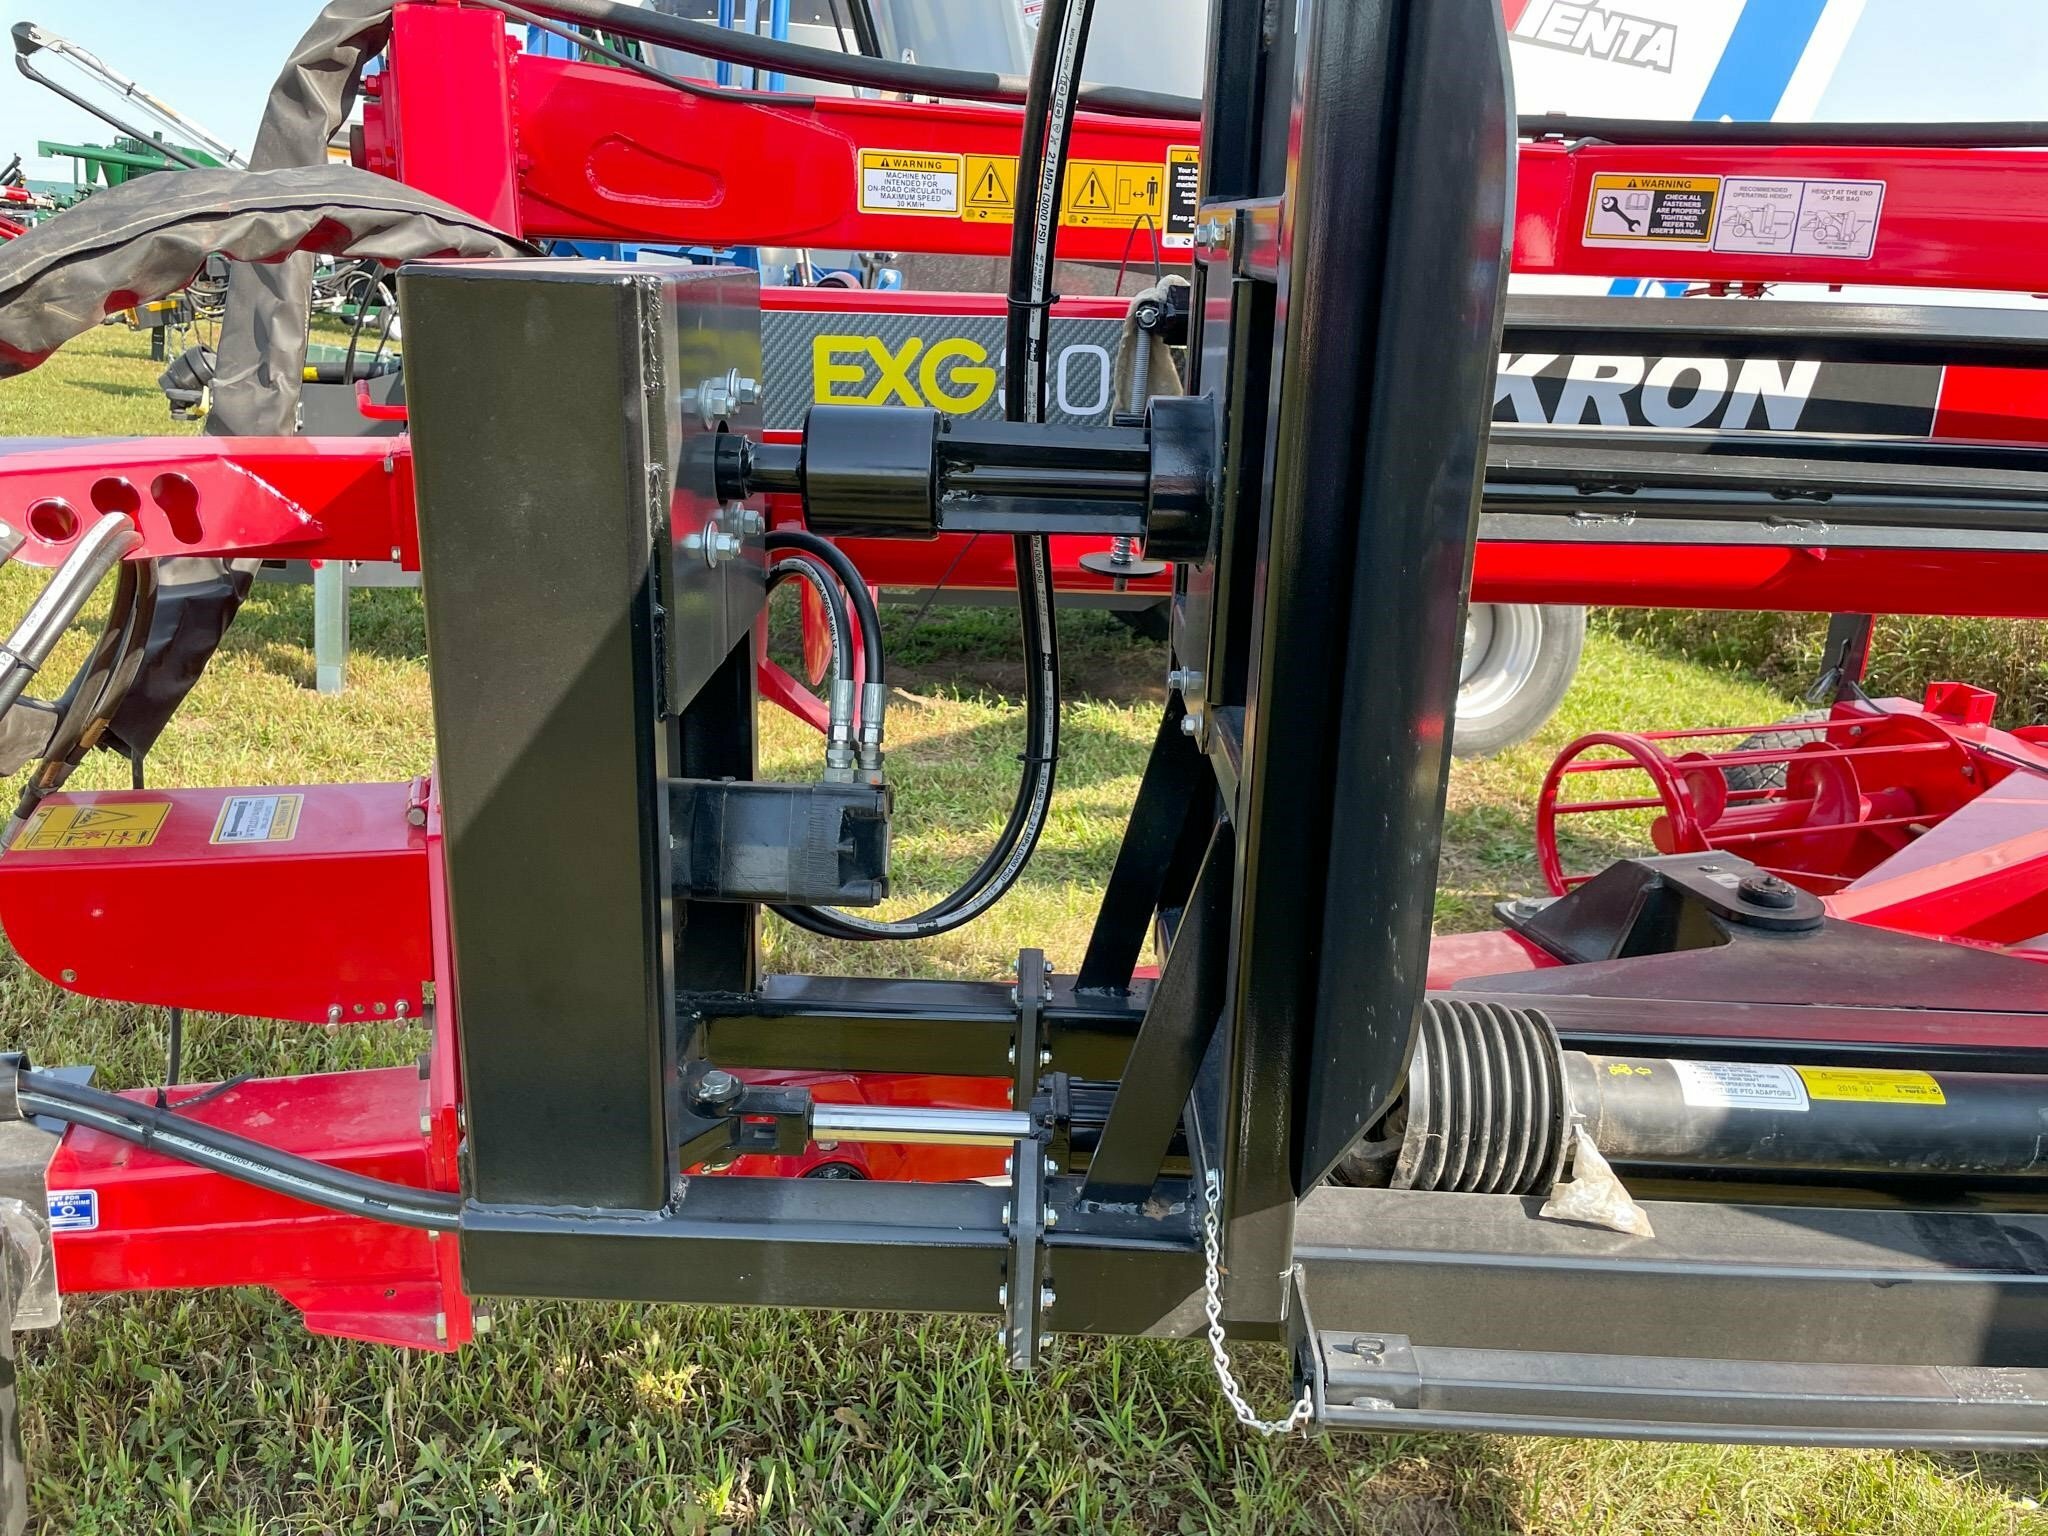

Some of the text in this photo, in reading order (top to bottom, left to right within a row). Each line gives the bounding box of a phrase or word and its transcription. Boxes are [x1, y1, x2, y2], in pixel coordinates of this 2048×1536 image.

[1048, 151, 1056, 163] 21
[893, 159, 942, 169] WARNING
[886, 172, 920, 180] MACHINE
[1043, 167, 1054, 190] MPa
[884, 179, 921, 187] INTENDED
[1641, 179, 1692, 189] WARNING
[867, 185, 952, 195] ON-ROAD CIRCULATION
[880, 193, 915, 201] MAXIMUM
[1040, 191, 1051, 221] (3000
[1037, 224, 1047, 244] PSI)
[813, 334, 996, 415] EXG
